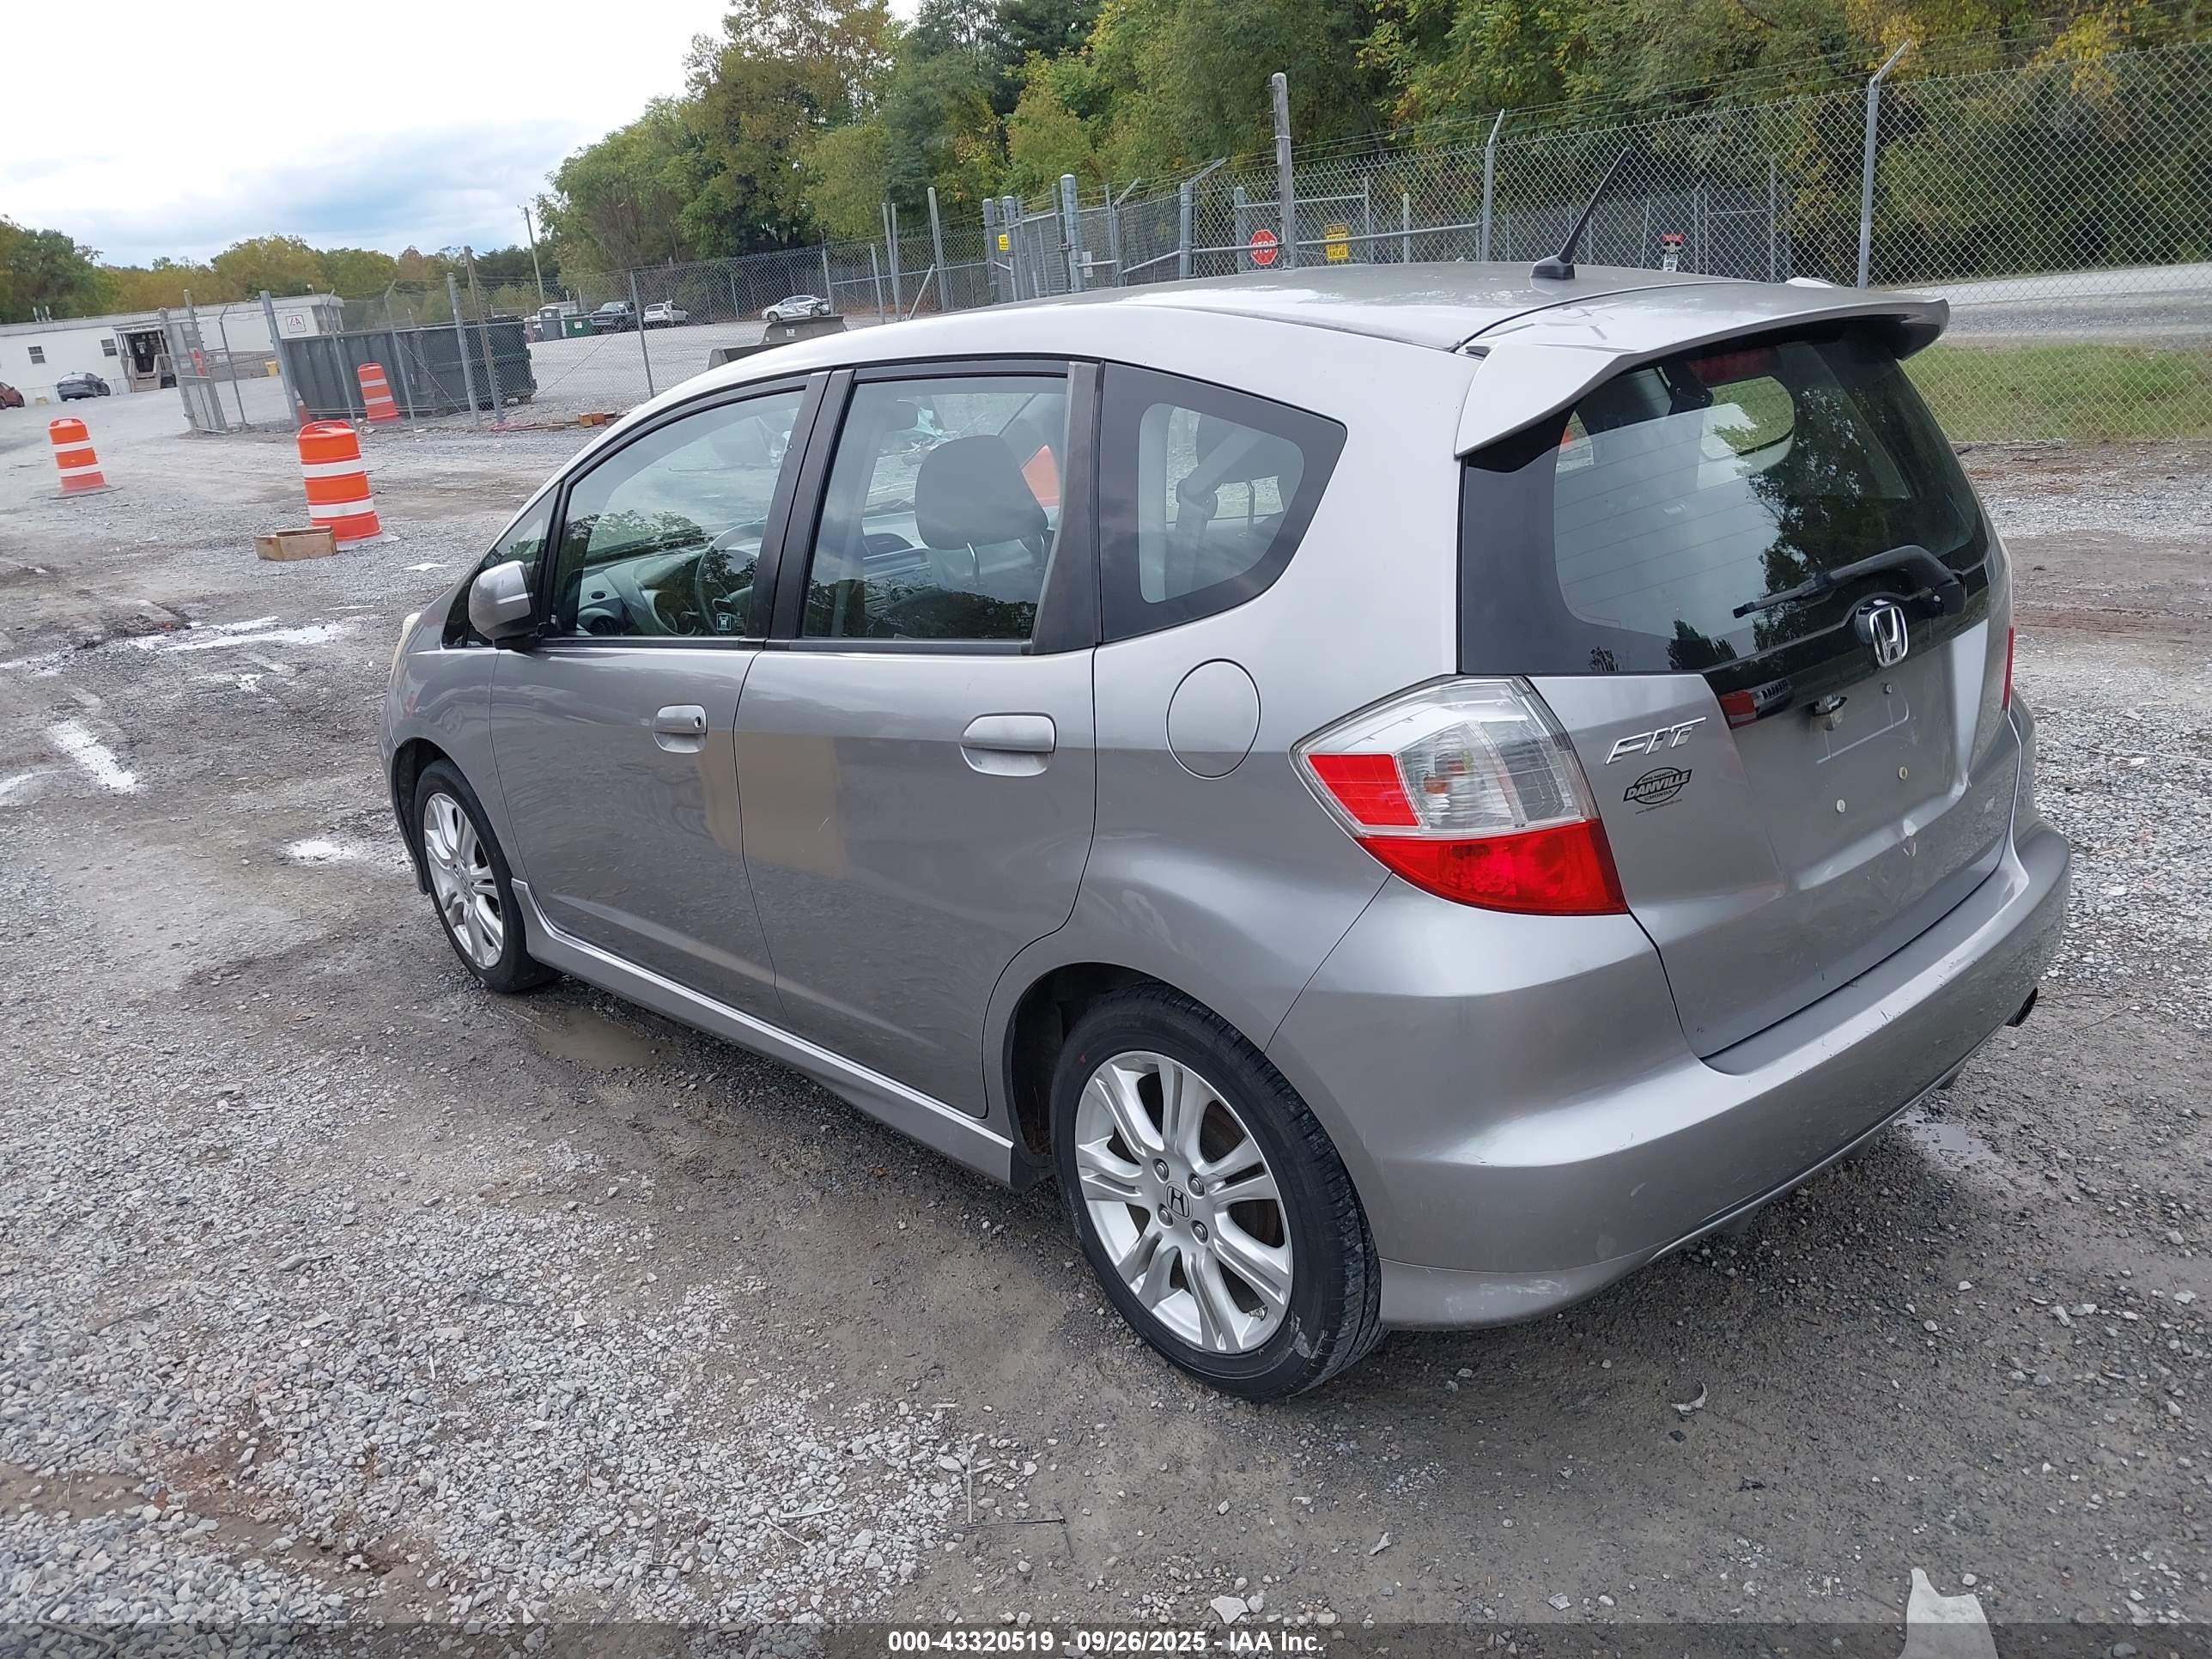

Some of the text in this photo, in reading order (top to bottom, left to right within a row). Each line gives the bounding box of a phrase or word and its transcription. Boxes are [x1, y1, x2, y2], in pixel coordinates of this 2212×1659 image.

[1253, 240, 1275, 255] STOP
[1605, 716, 1707, 765] FIT
[1626, 771, 1690, 799] DANVILLE
